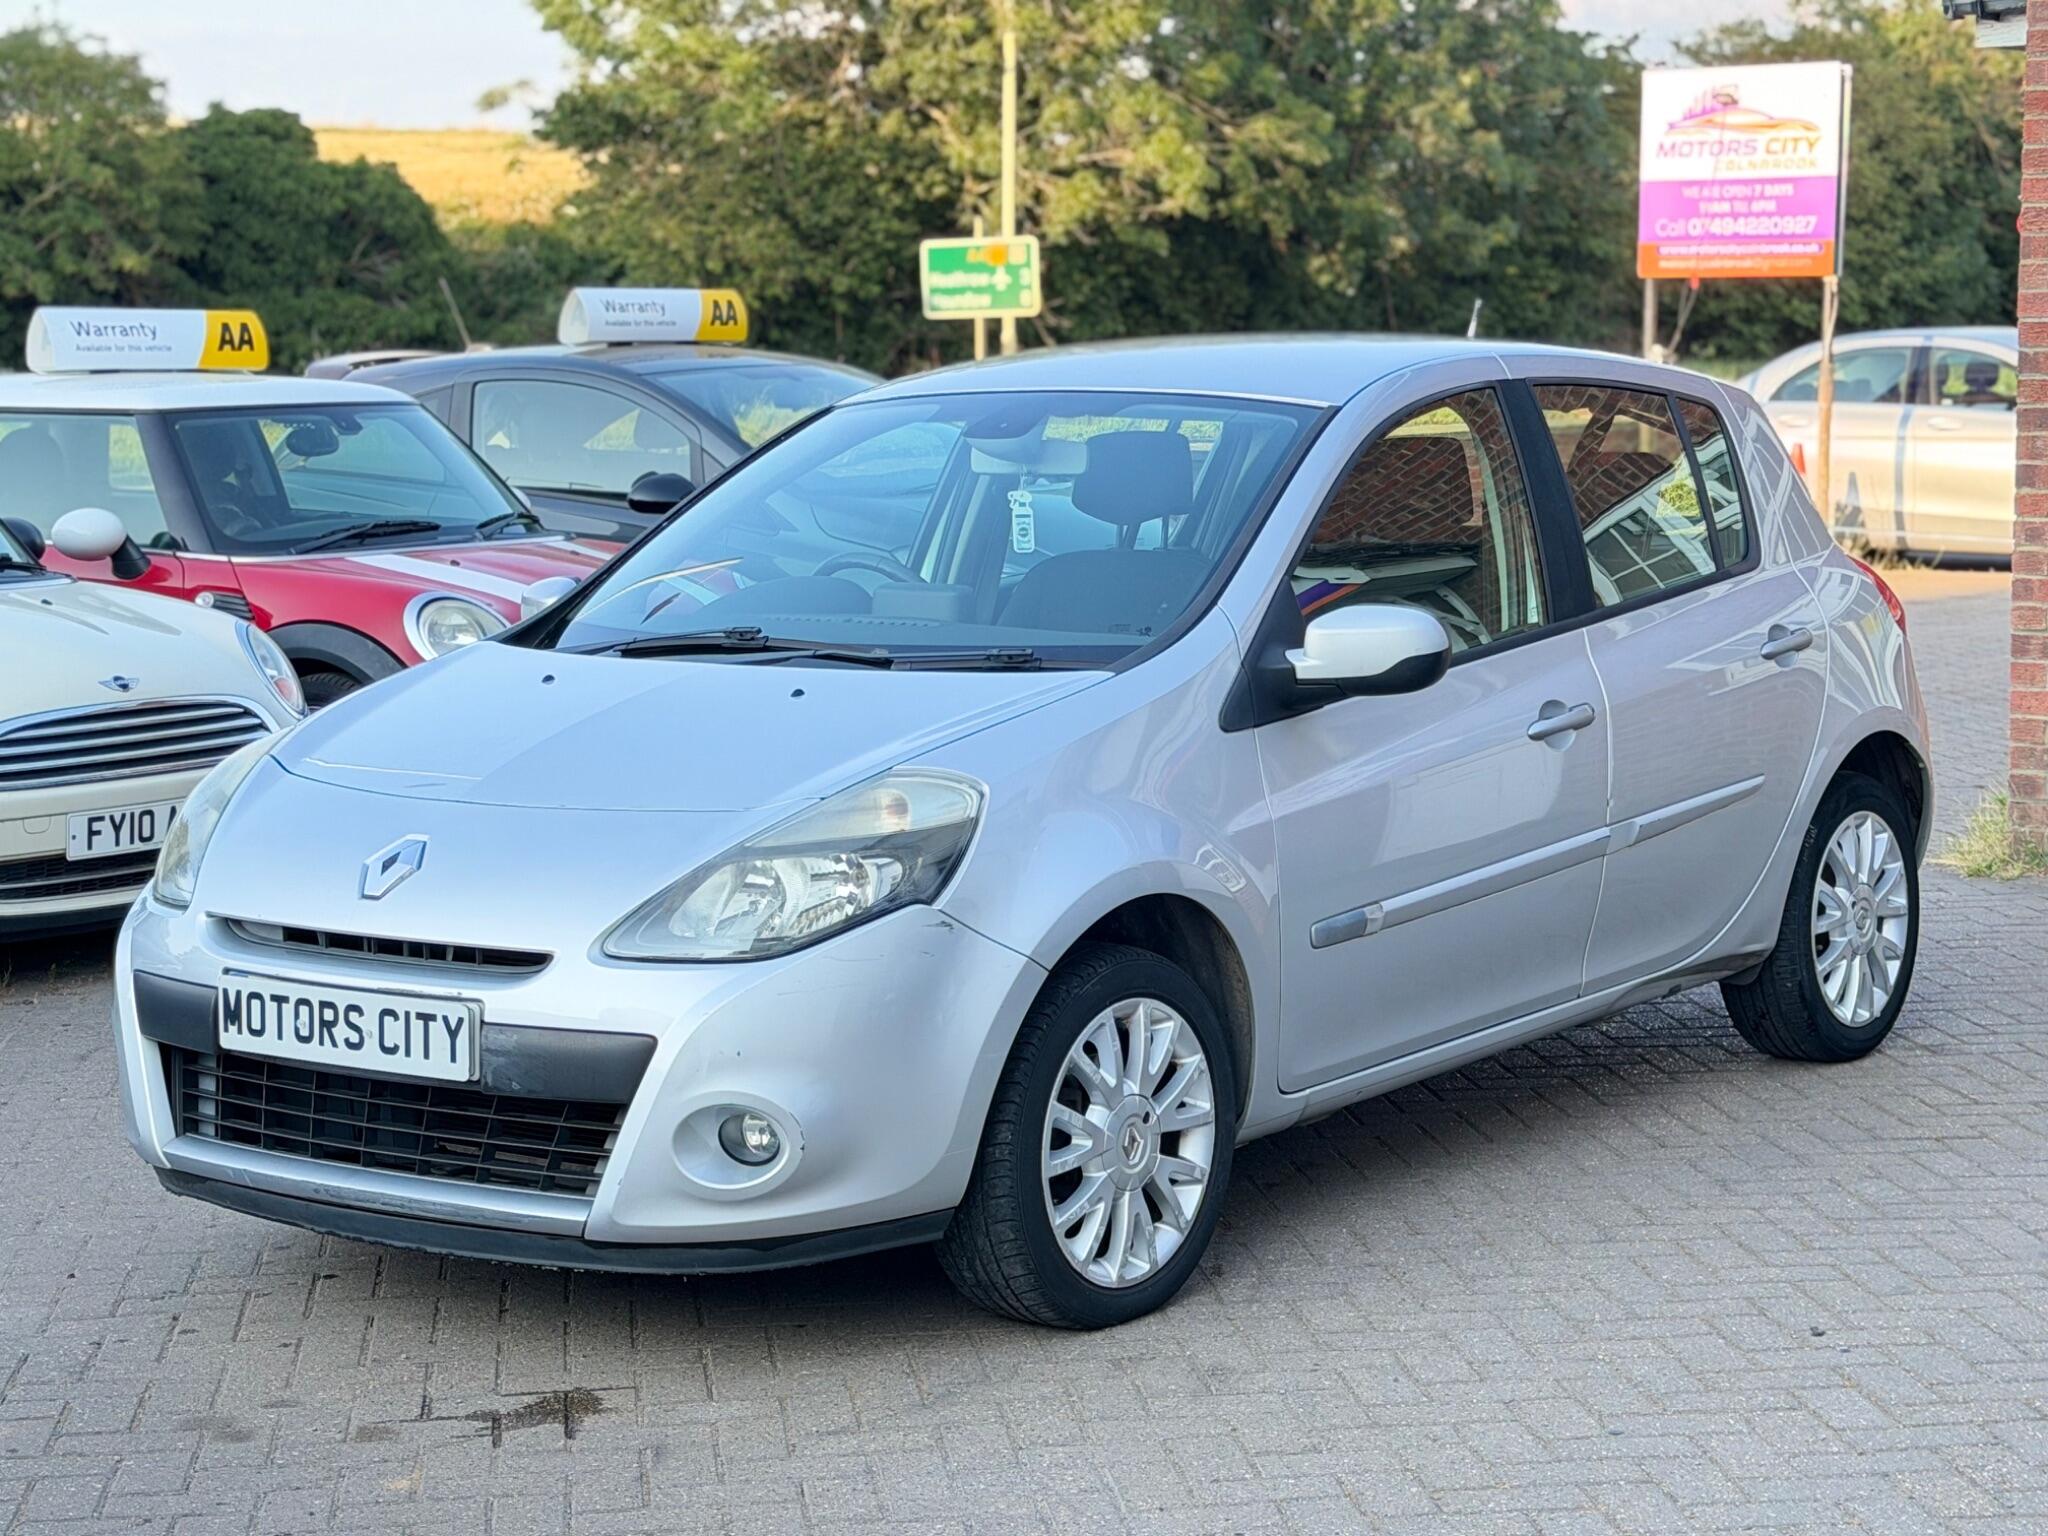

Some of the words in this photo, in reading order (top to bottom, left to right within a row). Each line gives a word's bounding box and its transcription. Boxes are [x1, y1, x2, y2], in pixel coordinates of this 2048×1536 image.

[1657, 138, 1758, 159] MOTORS
[1765, 136, 1822, 155] CITY
[1655, 217, 1686, 237] Call
[600, 299, 666, 316] Warranty
[710, 299, 738, 326] AA
[70, 320, 157, 341] Warranty
[217, 322, 254, 351] AA
[76, 344, 112, 353] Available
[115, 344, 125, 352] for
[128, 344, 142, 352] this
[145, 344, 172, 352] vehicle
[87, 809, 155, 851] FY10
[222, 987, 365, 1051] MOTORS
[378, 1008, 465, 1064] CITY
